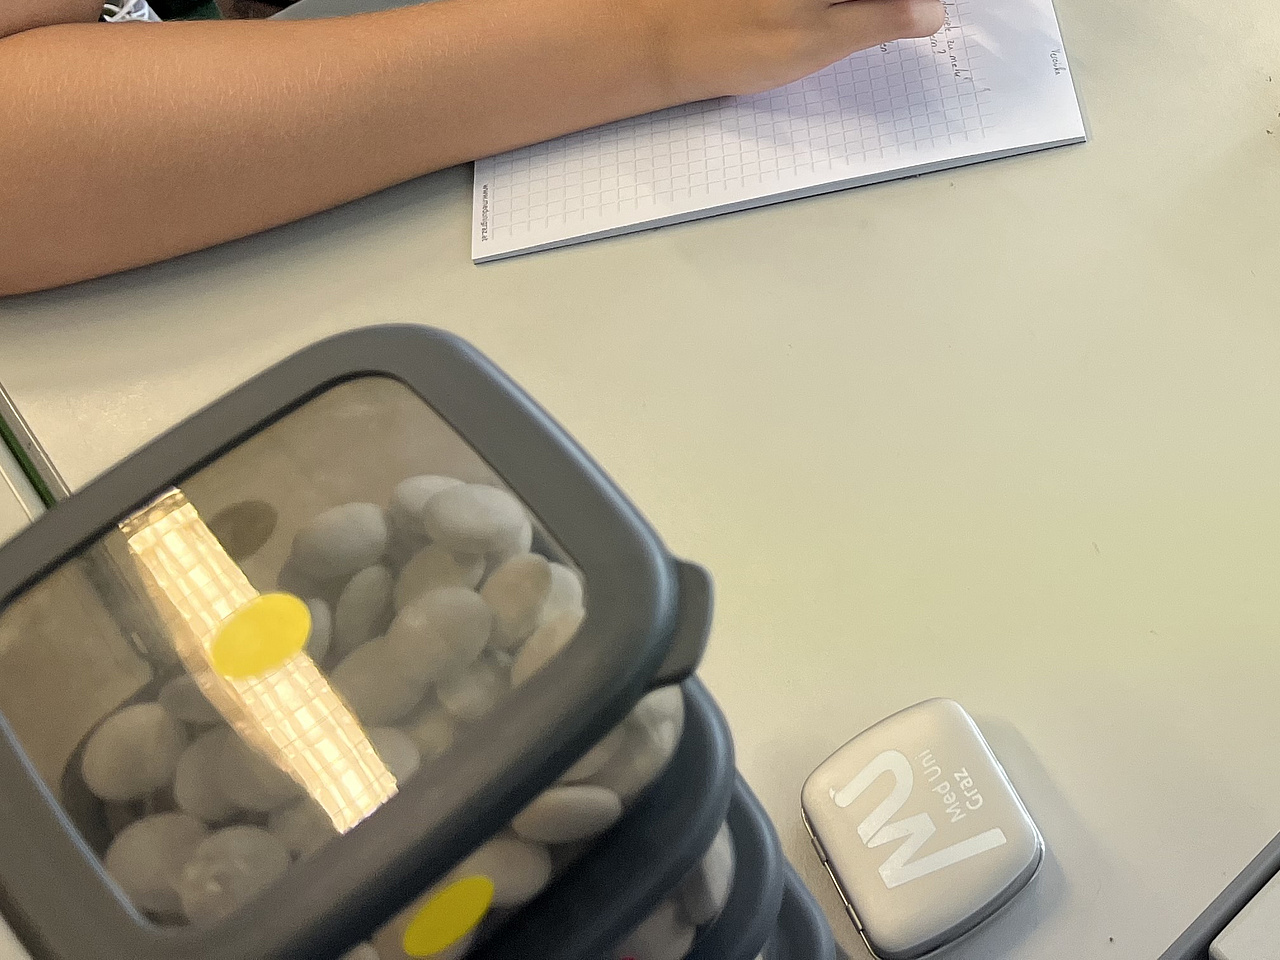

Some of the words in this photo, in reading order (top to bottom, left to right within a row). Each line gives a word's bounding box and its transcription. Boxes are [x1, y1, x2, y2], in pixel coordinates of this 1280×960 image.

[914, 749, 942, 783] Uni
[932, 782, 966, 823] Med
[954, 767, 984, 811] Graz
